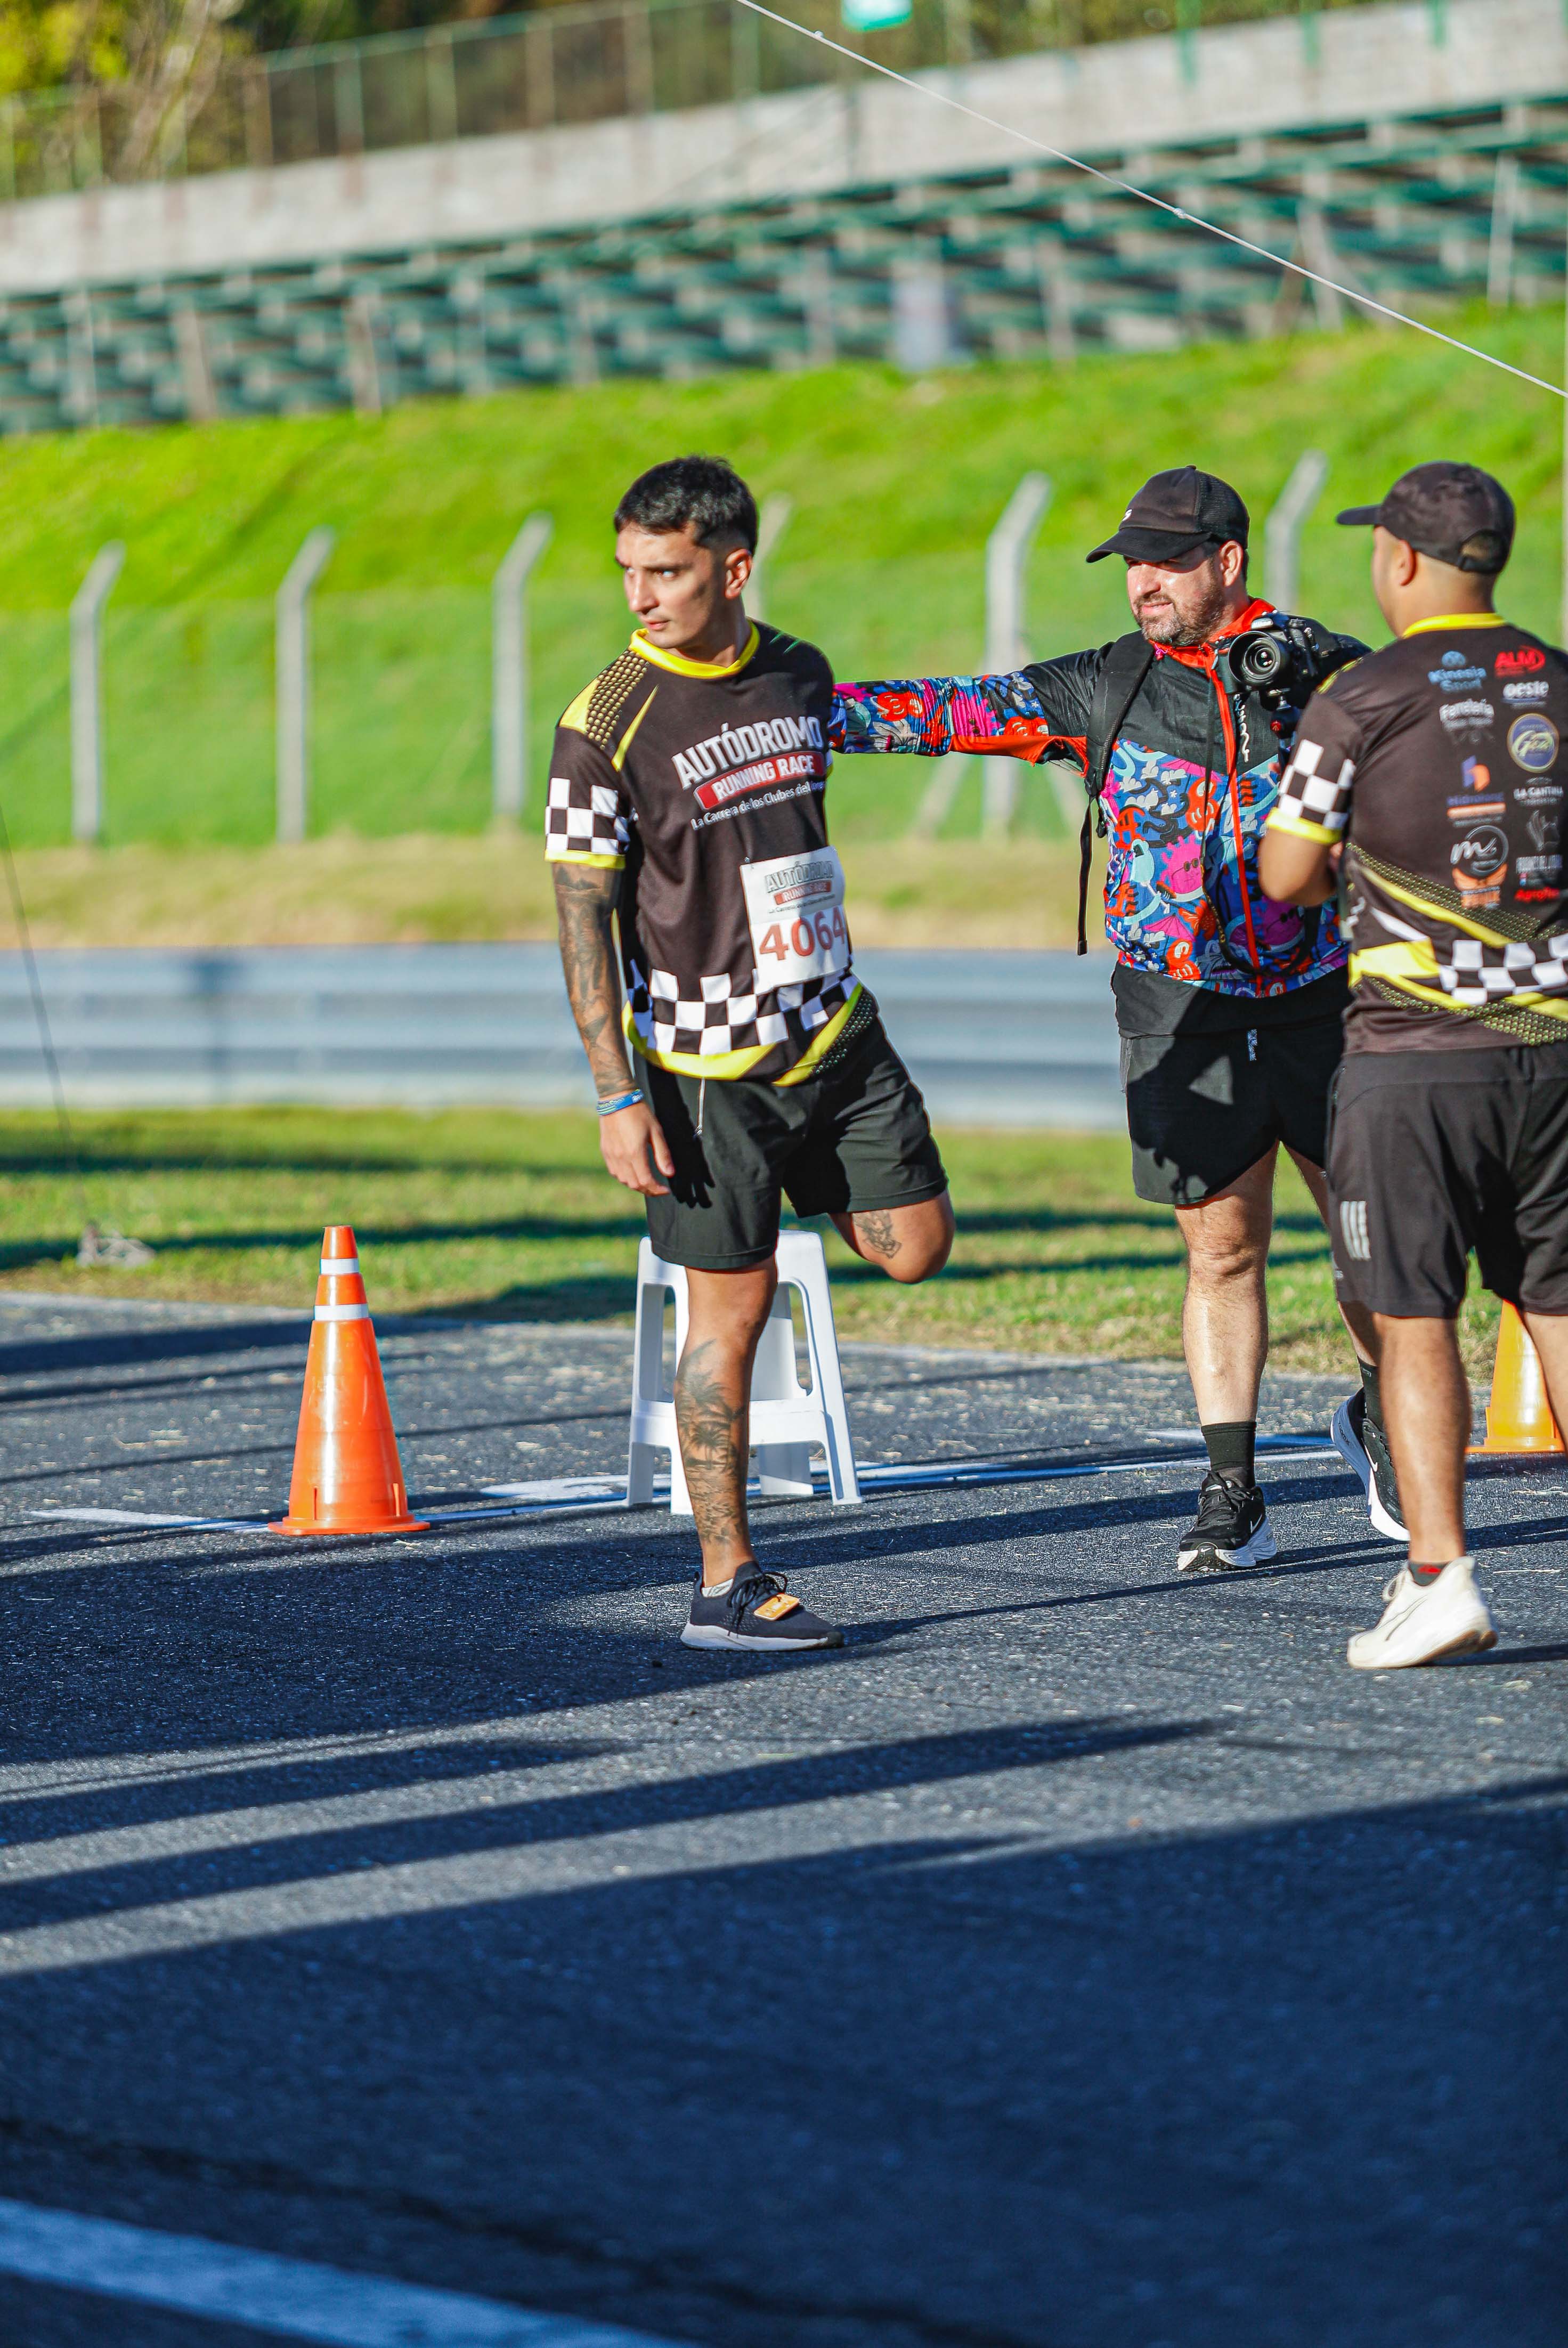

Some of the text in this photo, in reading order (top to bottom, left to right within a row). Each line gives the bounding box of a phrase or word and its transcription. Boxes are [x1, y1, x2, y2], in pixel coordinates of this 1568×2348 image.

[671, 716, 824, 790] AUTÓDROMO
[711, 754, 815, 802] RUNNING RACE
[690, 818, 705, 831] La
[703, 806, 740, 826] Carrera
[738, 800, 751, 814] de
[750, 797, 765, 810] los
[762, 789, 795, 806] Clubes
[759, 906, 845, 961] 4064
